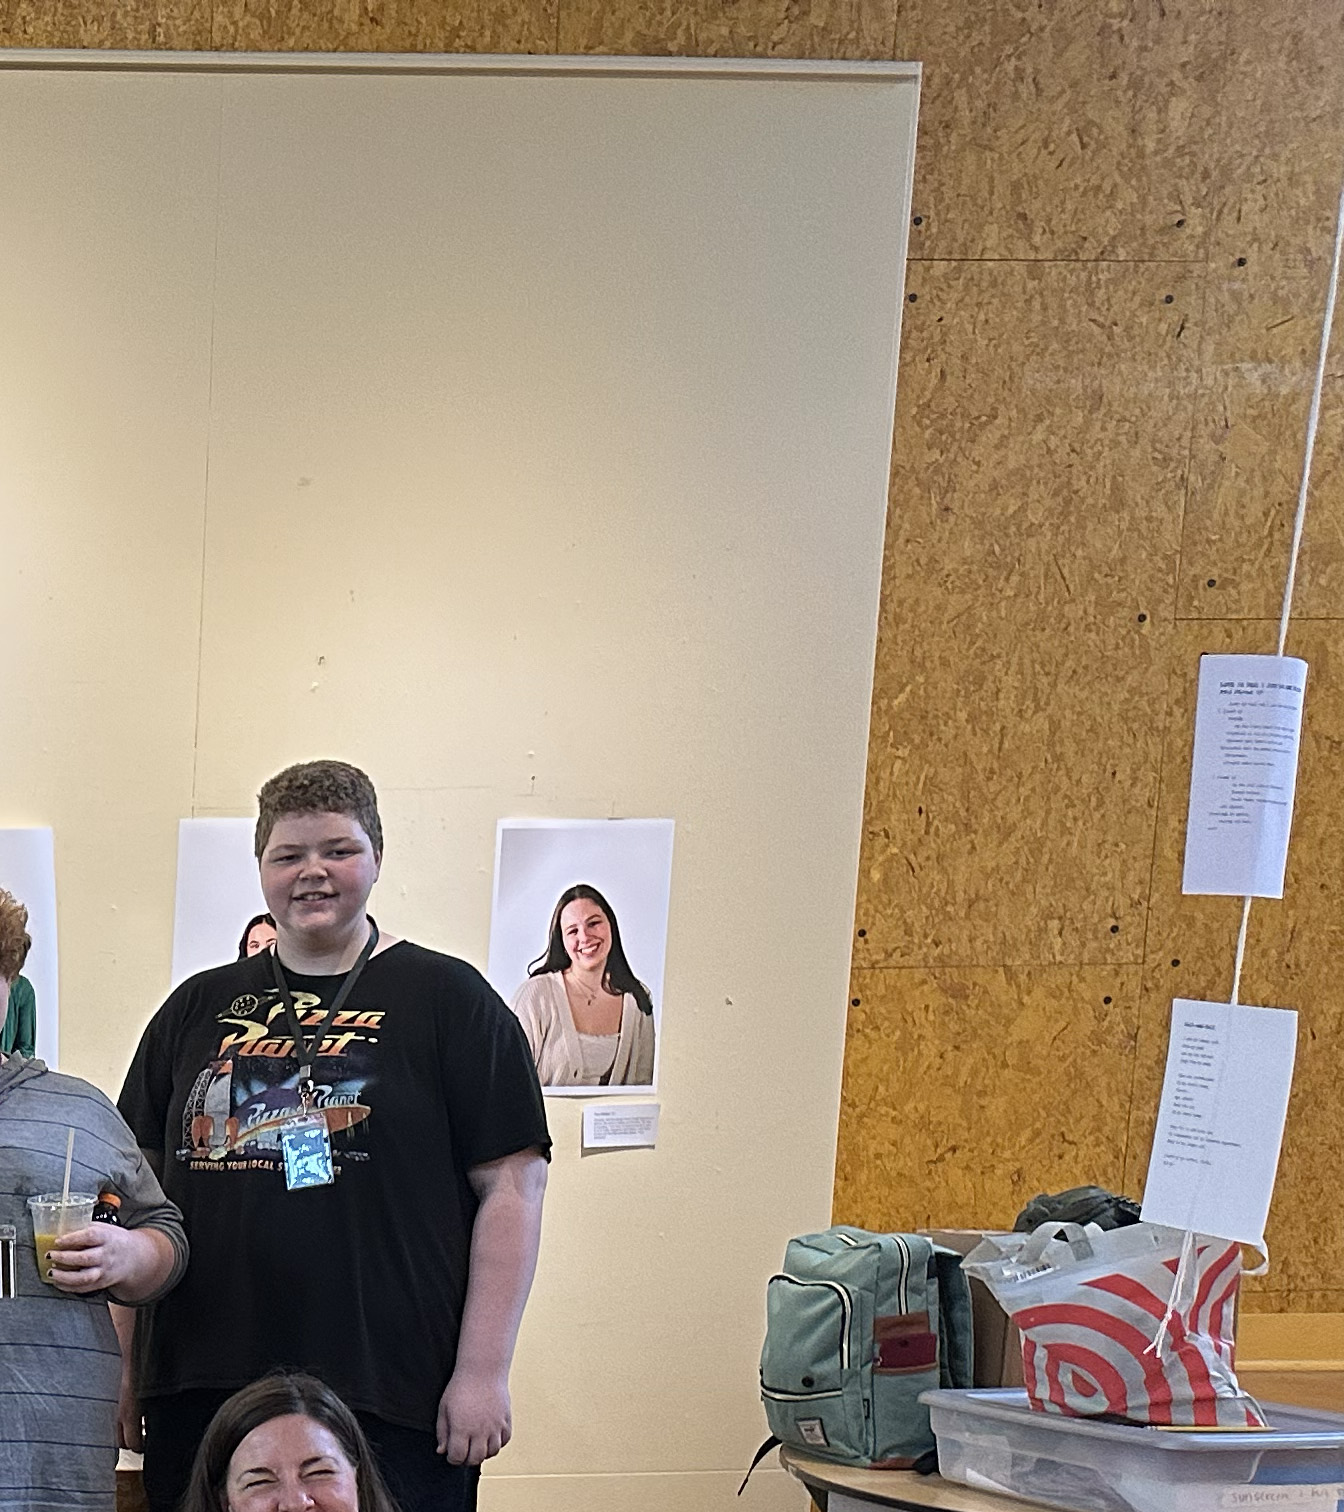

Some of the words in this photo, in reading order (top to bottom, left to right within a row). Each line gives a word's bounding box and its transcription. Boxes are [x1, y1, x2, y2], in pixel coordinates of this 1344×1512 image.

[189, 1161, 225, 1172] SERVING
[226, 1161, 248, 1171] YOUR
[249, 1160, 274, 1171] LOCAL
